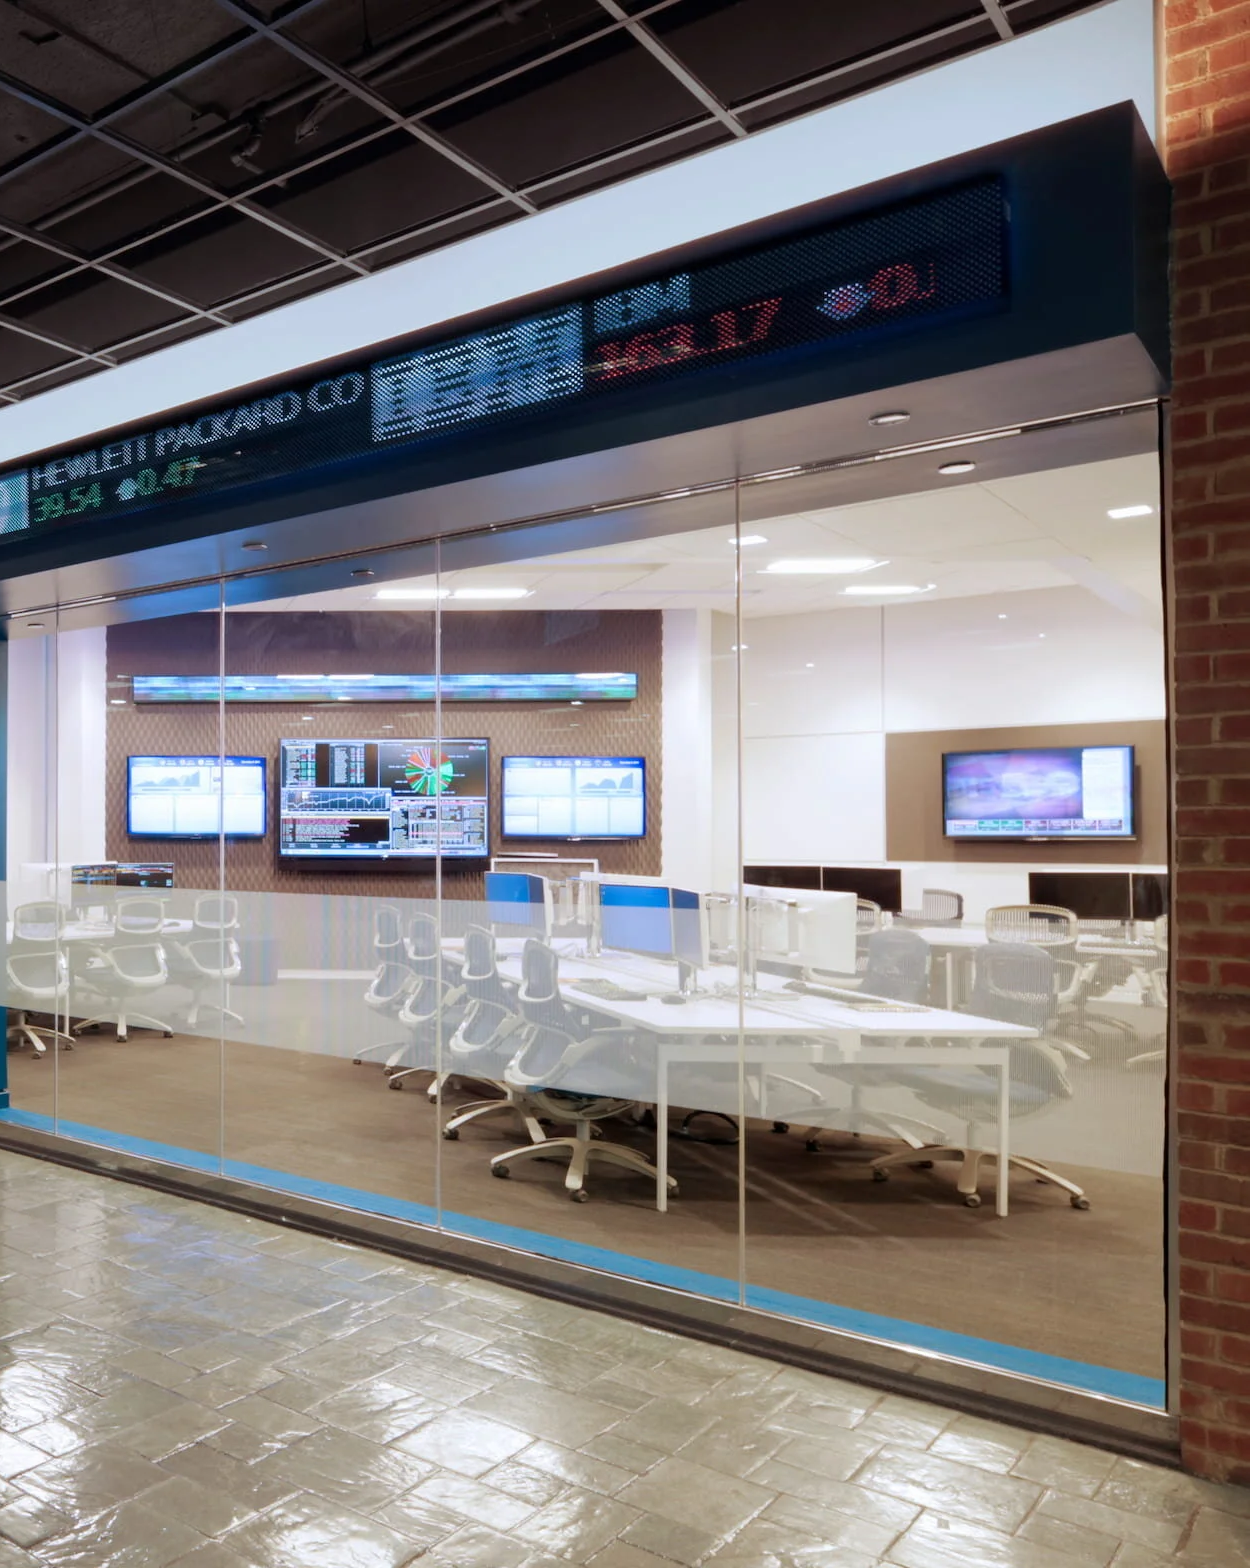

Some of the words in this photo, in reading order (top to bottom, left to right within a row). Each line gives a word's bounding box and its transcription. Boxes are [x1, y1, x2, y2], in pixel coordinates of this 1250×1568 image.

[156, 390, 302, 457] PACKARD
[306, 372, 365, 413] CO
[371, 303, 585, 443] IBM
[33, 482, 104, 524] 39.54
